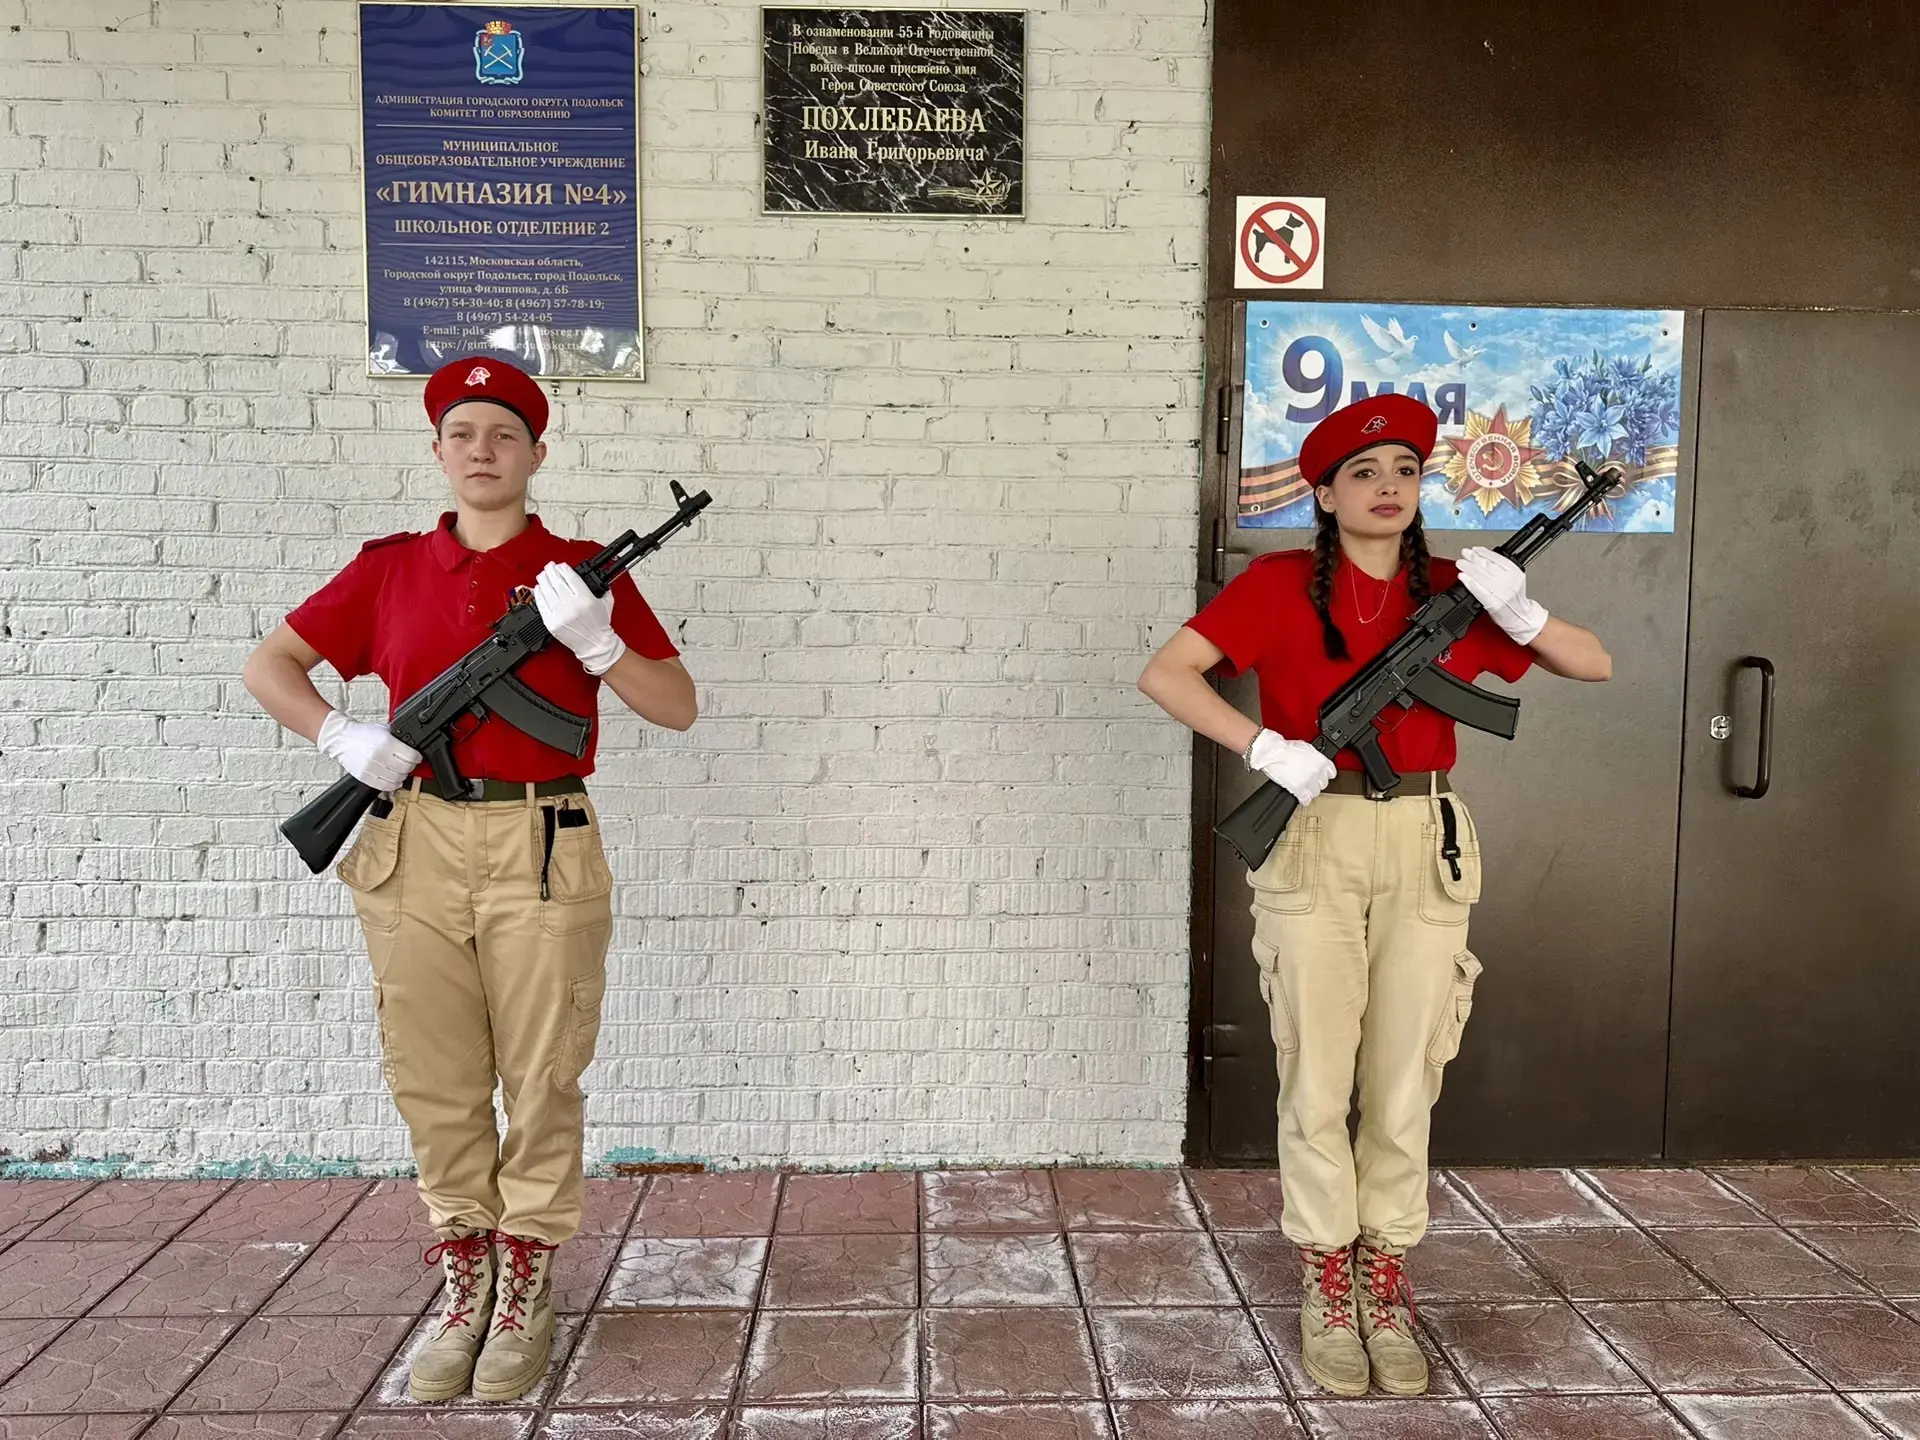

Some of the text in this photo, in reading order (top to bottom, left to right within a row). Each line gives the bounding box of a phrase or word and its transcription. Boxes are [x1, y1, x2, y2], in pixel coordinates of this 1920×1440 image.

[793, 24, 801, 37] В
[806, 28, 894, 38] ознаменовании
[899, 26, 924, 38] 55-й
[793, 42, 994, 57] Победы в Великой Отечественной
[849, 63, 885, 73] школе
[891, 64, 950, 76] присвоено
[955, 65, 977, 75] имя
[821, 78, 966, 93] Героя Советского Союза
[375, 95, 624, 108] АДМИНИСТРАЦИЯ ГОРОДСКОГО ОКРУГА ПОДОЛЬСК
[430, 109, 571, 119] КОМИТЕТ ПО ОБРАЗОВАНИЮ
[802, 106, 987, 133] ПОХЛЕБАЕВА
[443, 140, 559, 153] МУНИЦИПАЛЬНОЕ
[804, 140, 984, 164] Ивана Григорьевича
[376, 155, 626, 169] ОБЩЕОБРАЗОВАТЕЛЬНОЕ УЧРЕЖДЕНИЕ
[376, 181, 627, 206] «ГИМНАЗИЯ №4»
[395, 219, 609, 236] ШКОЛЬНОЕ ОТДЕЛЕНИЕ 2
[424, 256, 584, 268] 142115, Московская область,
[384, 269, 623, 284] Городской округ Подольск, город Подольск,
[439, 284, 569, 296] улица Филиппова, д. 6Б
[403, 297, 605, 310] 8 (4967) 54-30-40; 8 (4967) 57-78-19;
[456, 311, 553, 324] 8 (4967) 54-24-05
[423, 326, 460, 336] E-mail:
[1282, 335, 1344, 423] 9
[1468, 435, 1517, 482] ОТЕЧЕСТВЕННАЯ
